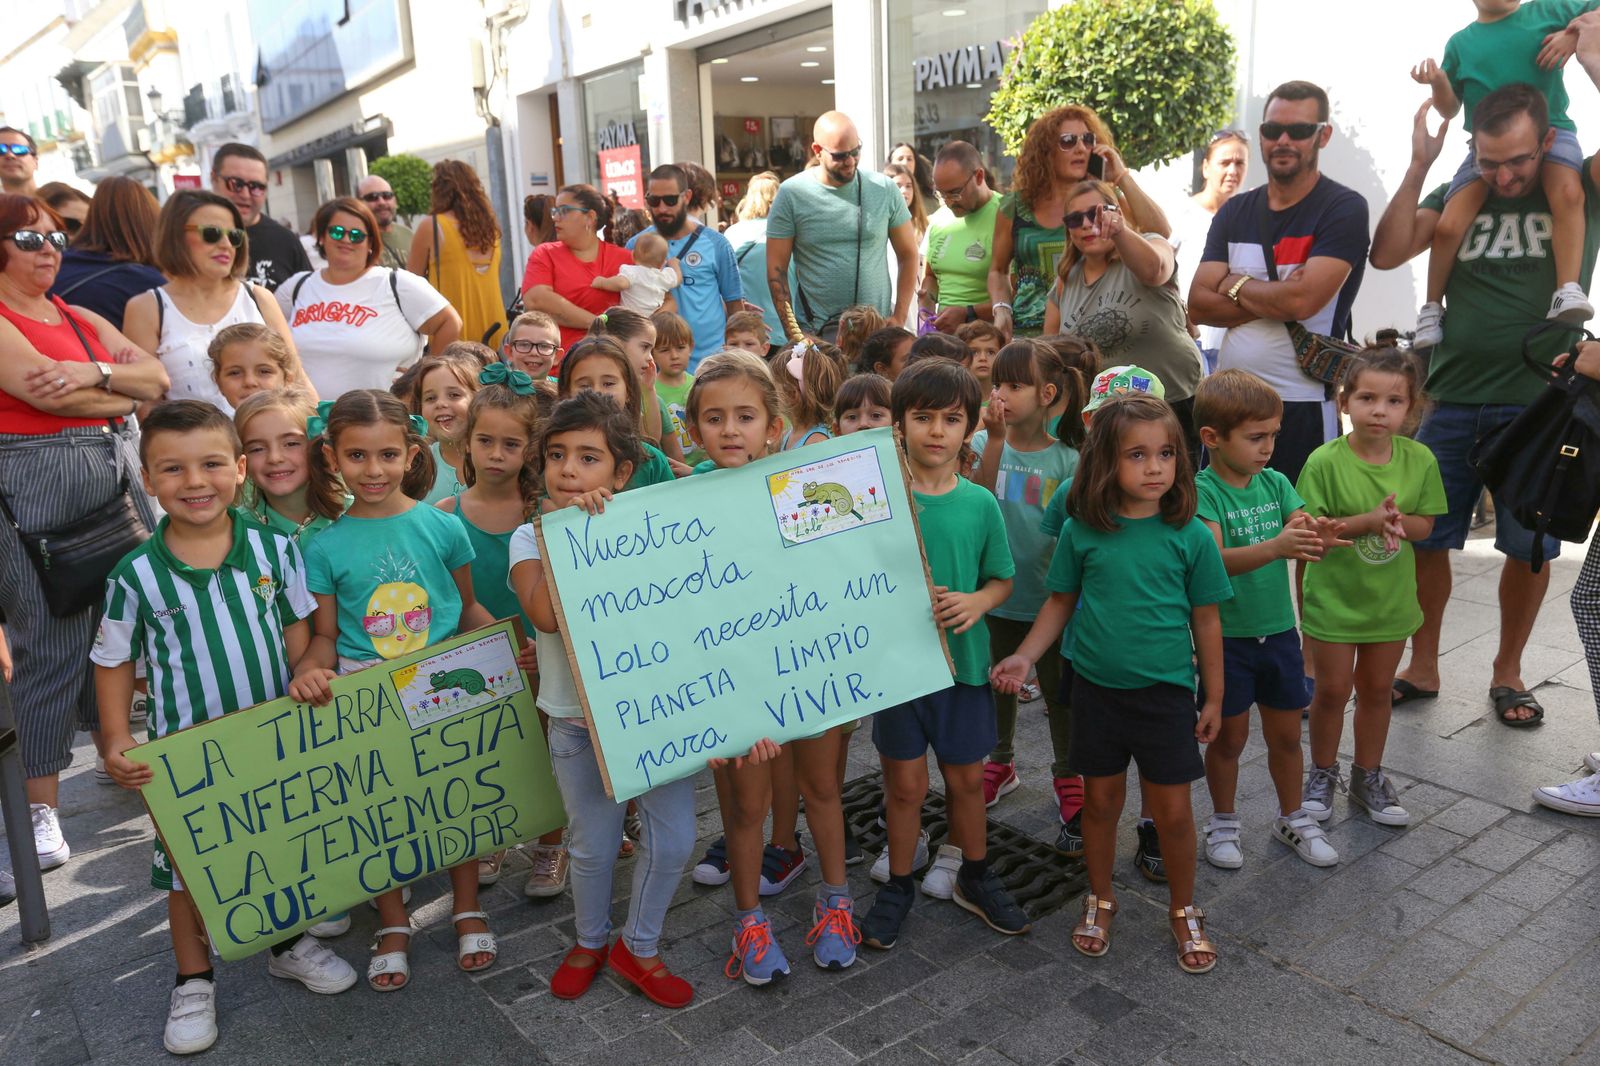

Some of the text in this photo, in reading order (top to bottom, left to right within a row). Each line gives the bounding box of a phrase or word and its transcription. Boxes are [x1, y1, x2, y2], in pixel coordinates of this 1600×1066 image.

[914, 41, 1003, 92] PAYMA
[598, 121, 637, 151] PAYMA
[1457, 212, 1553, 262] GAP
[1506, 262, 1541, 274] YORK
[292, 301, 378, 327] BRIGHT
[565, 511, 715, 570] Nuestra
[1226, 509, 1249, 520] NITED
[1231, 520, 1279, 536] BENETTON
[1248, 516, 1259, 524] OF
[581, 550, 752, 622] mascota
[694, 582, 828, 651] necesita
[844, 570, 897, 601] un
[616, 668, 735, 730] PLANETA
[159, 739, 235, 799] LA
[183, 694, 525, 855] ENFERMA ESTÁ
[636, 727, 727, 788] para
[203, 761, 505, 905] LA TENEMOS
[225, 874, 328, 945] QUE
